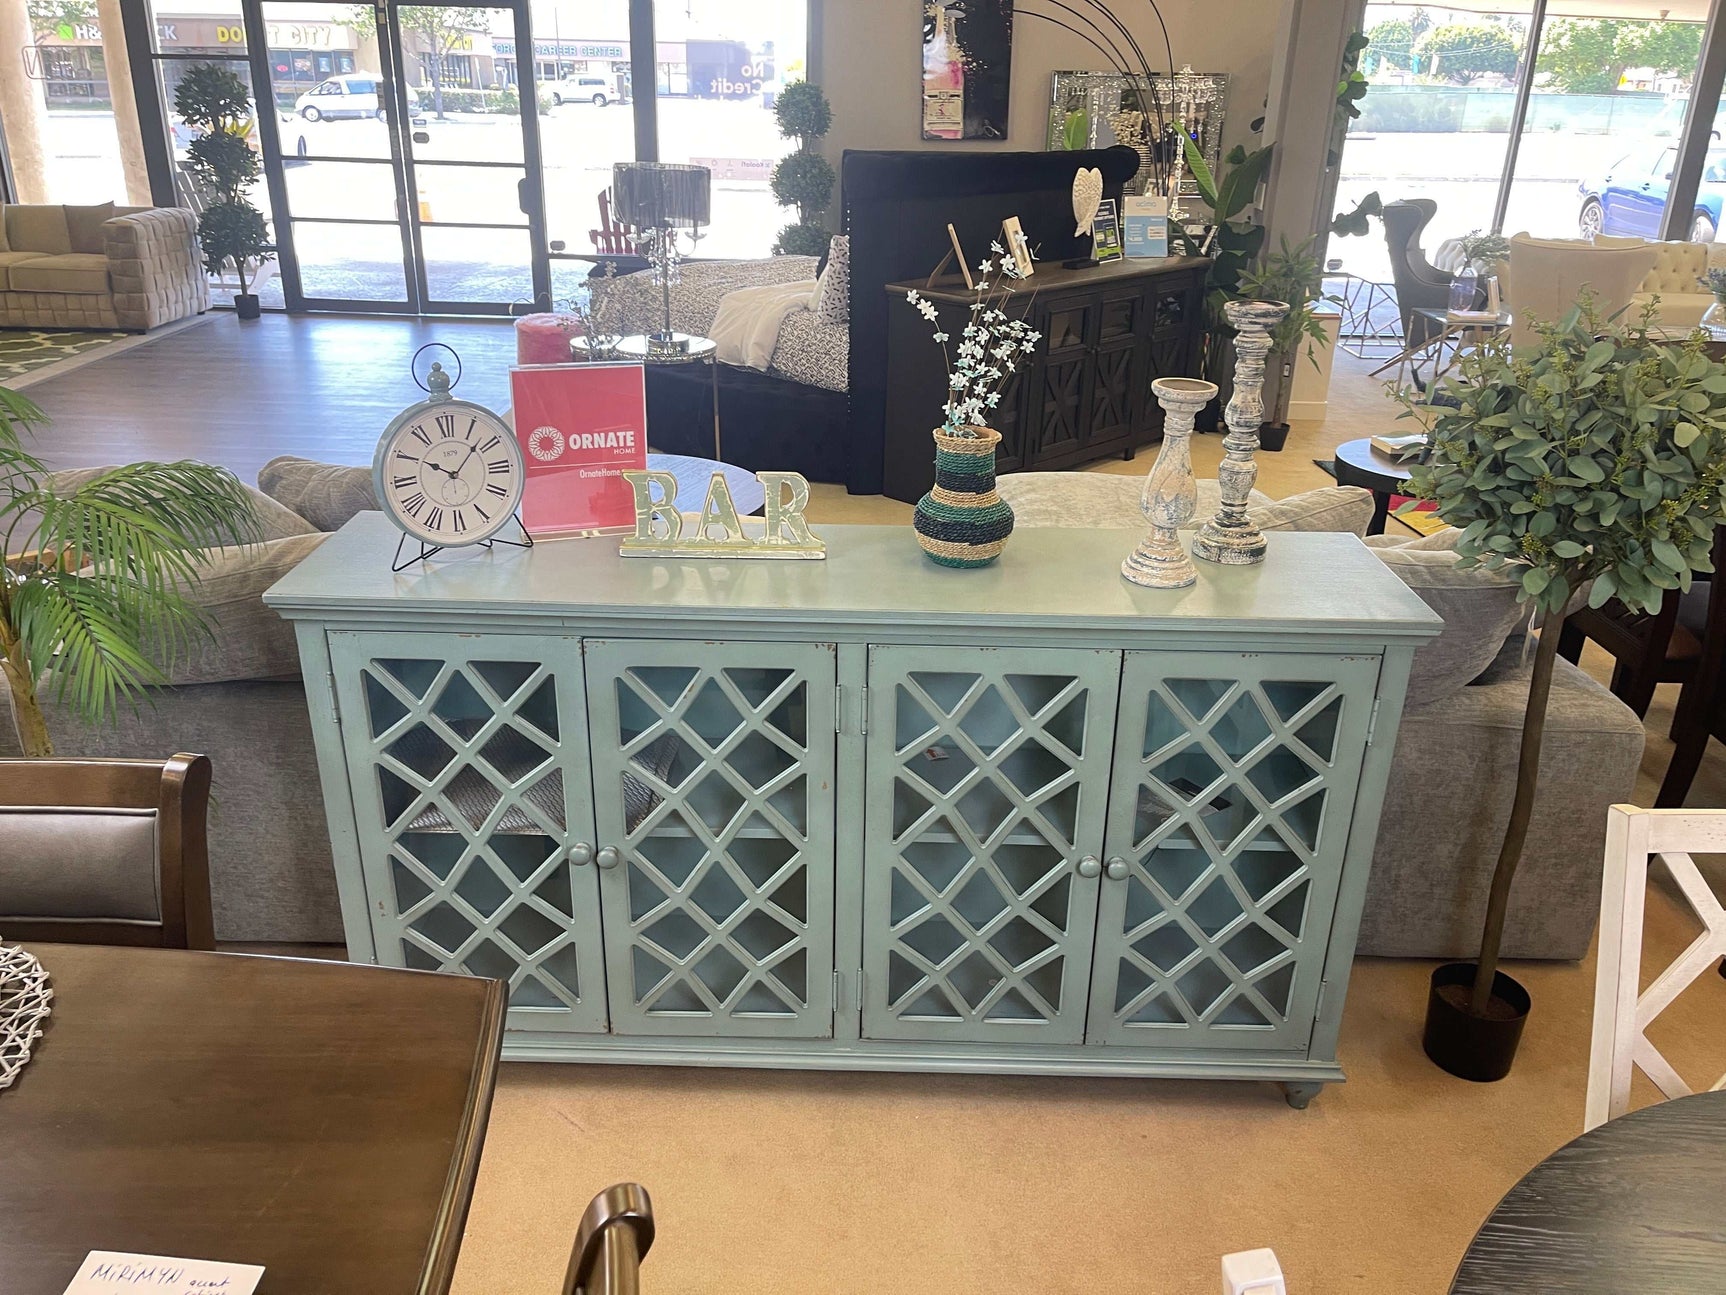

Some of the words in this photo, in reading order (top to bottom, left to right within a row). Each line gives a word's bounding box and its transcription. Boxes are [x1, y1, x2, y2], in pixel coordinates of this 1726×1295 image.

[75, 24, 102, 40] H&
[535, 45, 578, 56] CAREER
[581, 46, 622, 57] CENTER
[569, 431, 635, 449] ORNATE
[443, 450, 458, 458] 1879
[622, 469, 824, 548] BAR
